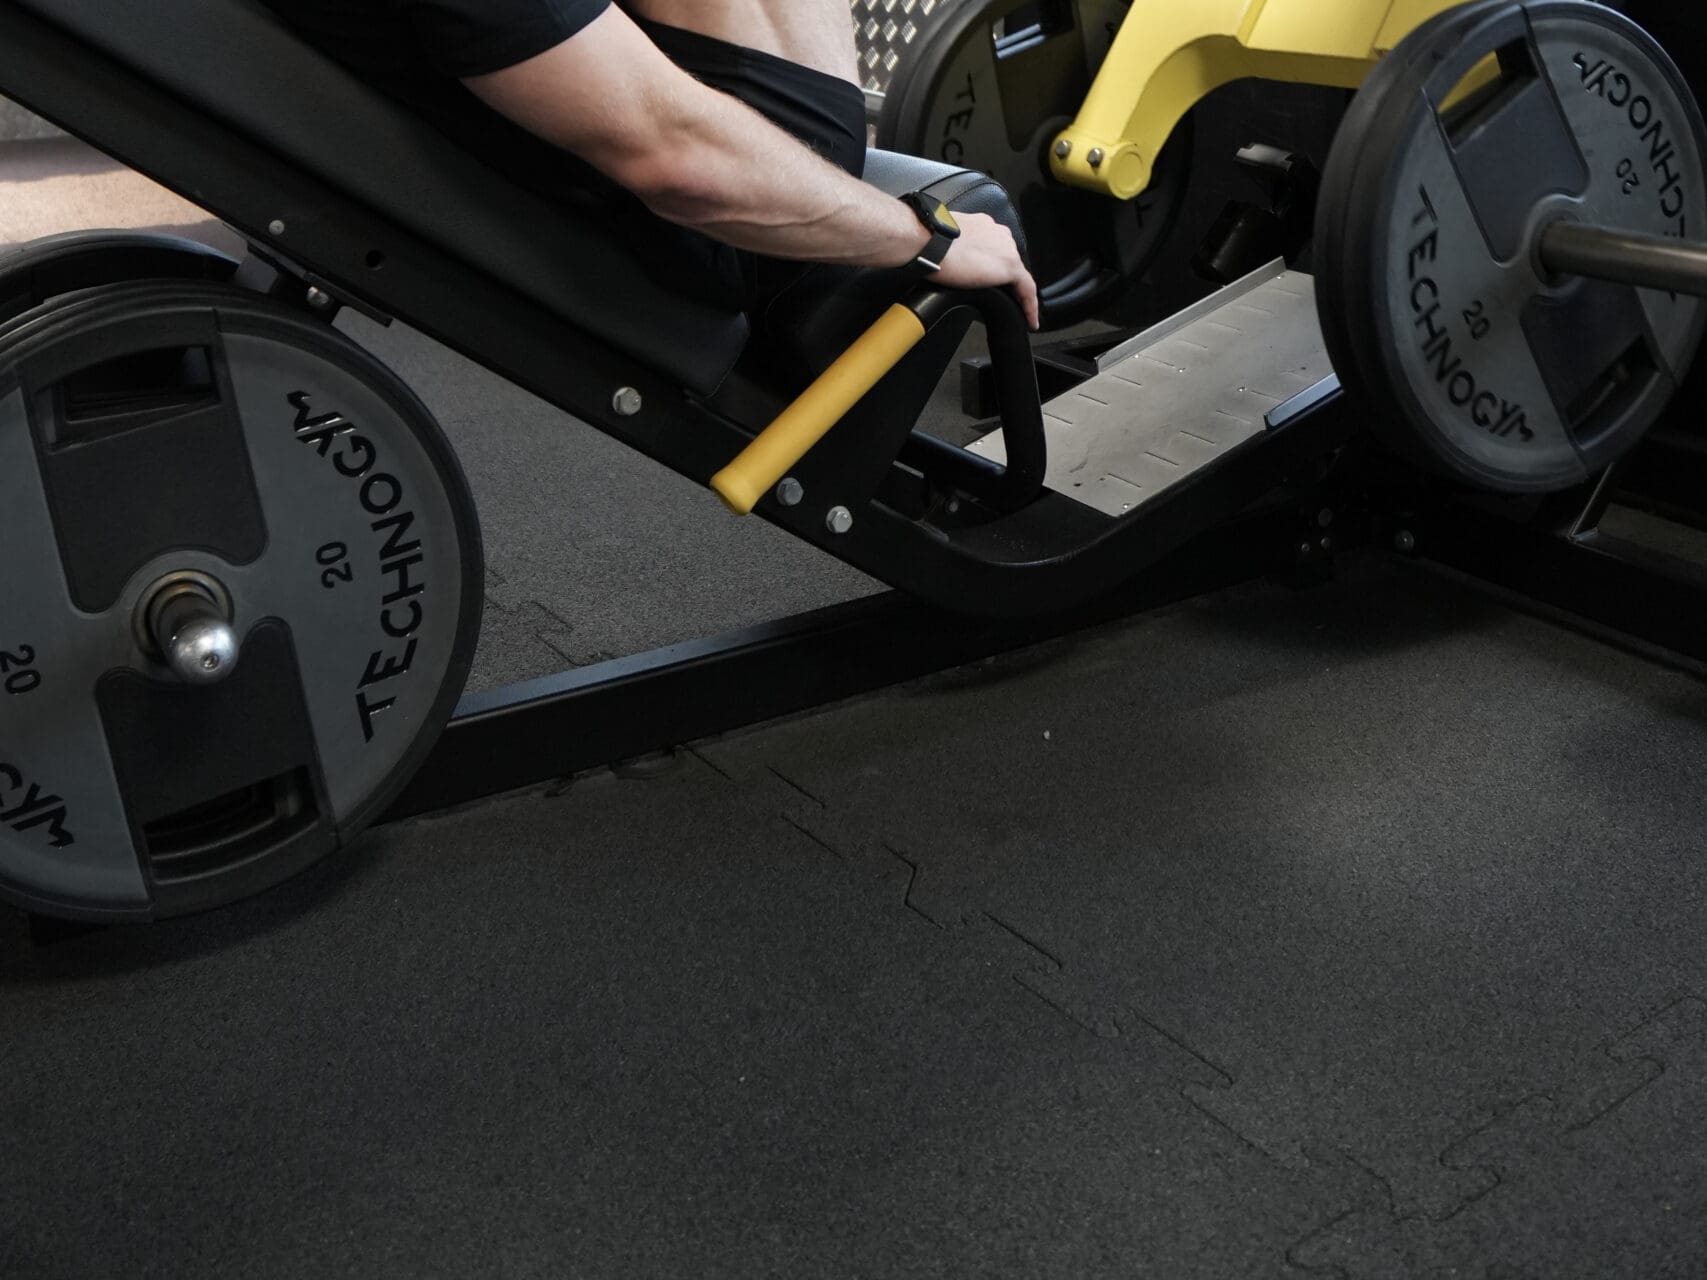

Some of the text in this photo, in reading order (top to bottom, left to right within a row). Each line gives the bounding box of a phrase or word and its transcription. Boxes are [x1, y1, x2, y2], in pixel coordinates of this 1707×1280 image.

[1573, 51, 1686, 302] CHNOGYM
[1615, 158, 1639, 195] 20
[1408, 183, 1534, 442] TECHNOGYM
[1461, 300, 1491, 340] 20
[286, 390, 425, 744] TECHNOGYM
[315, 541, 353, 589] 20
[0, 644, 41, 695] 20
